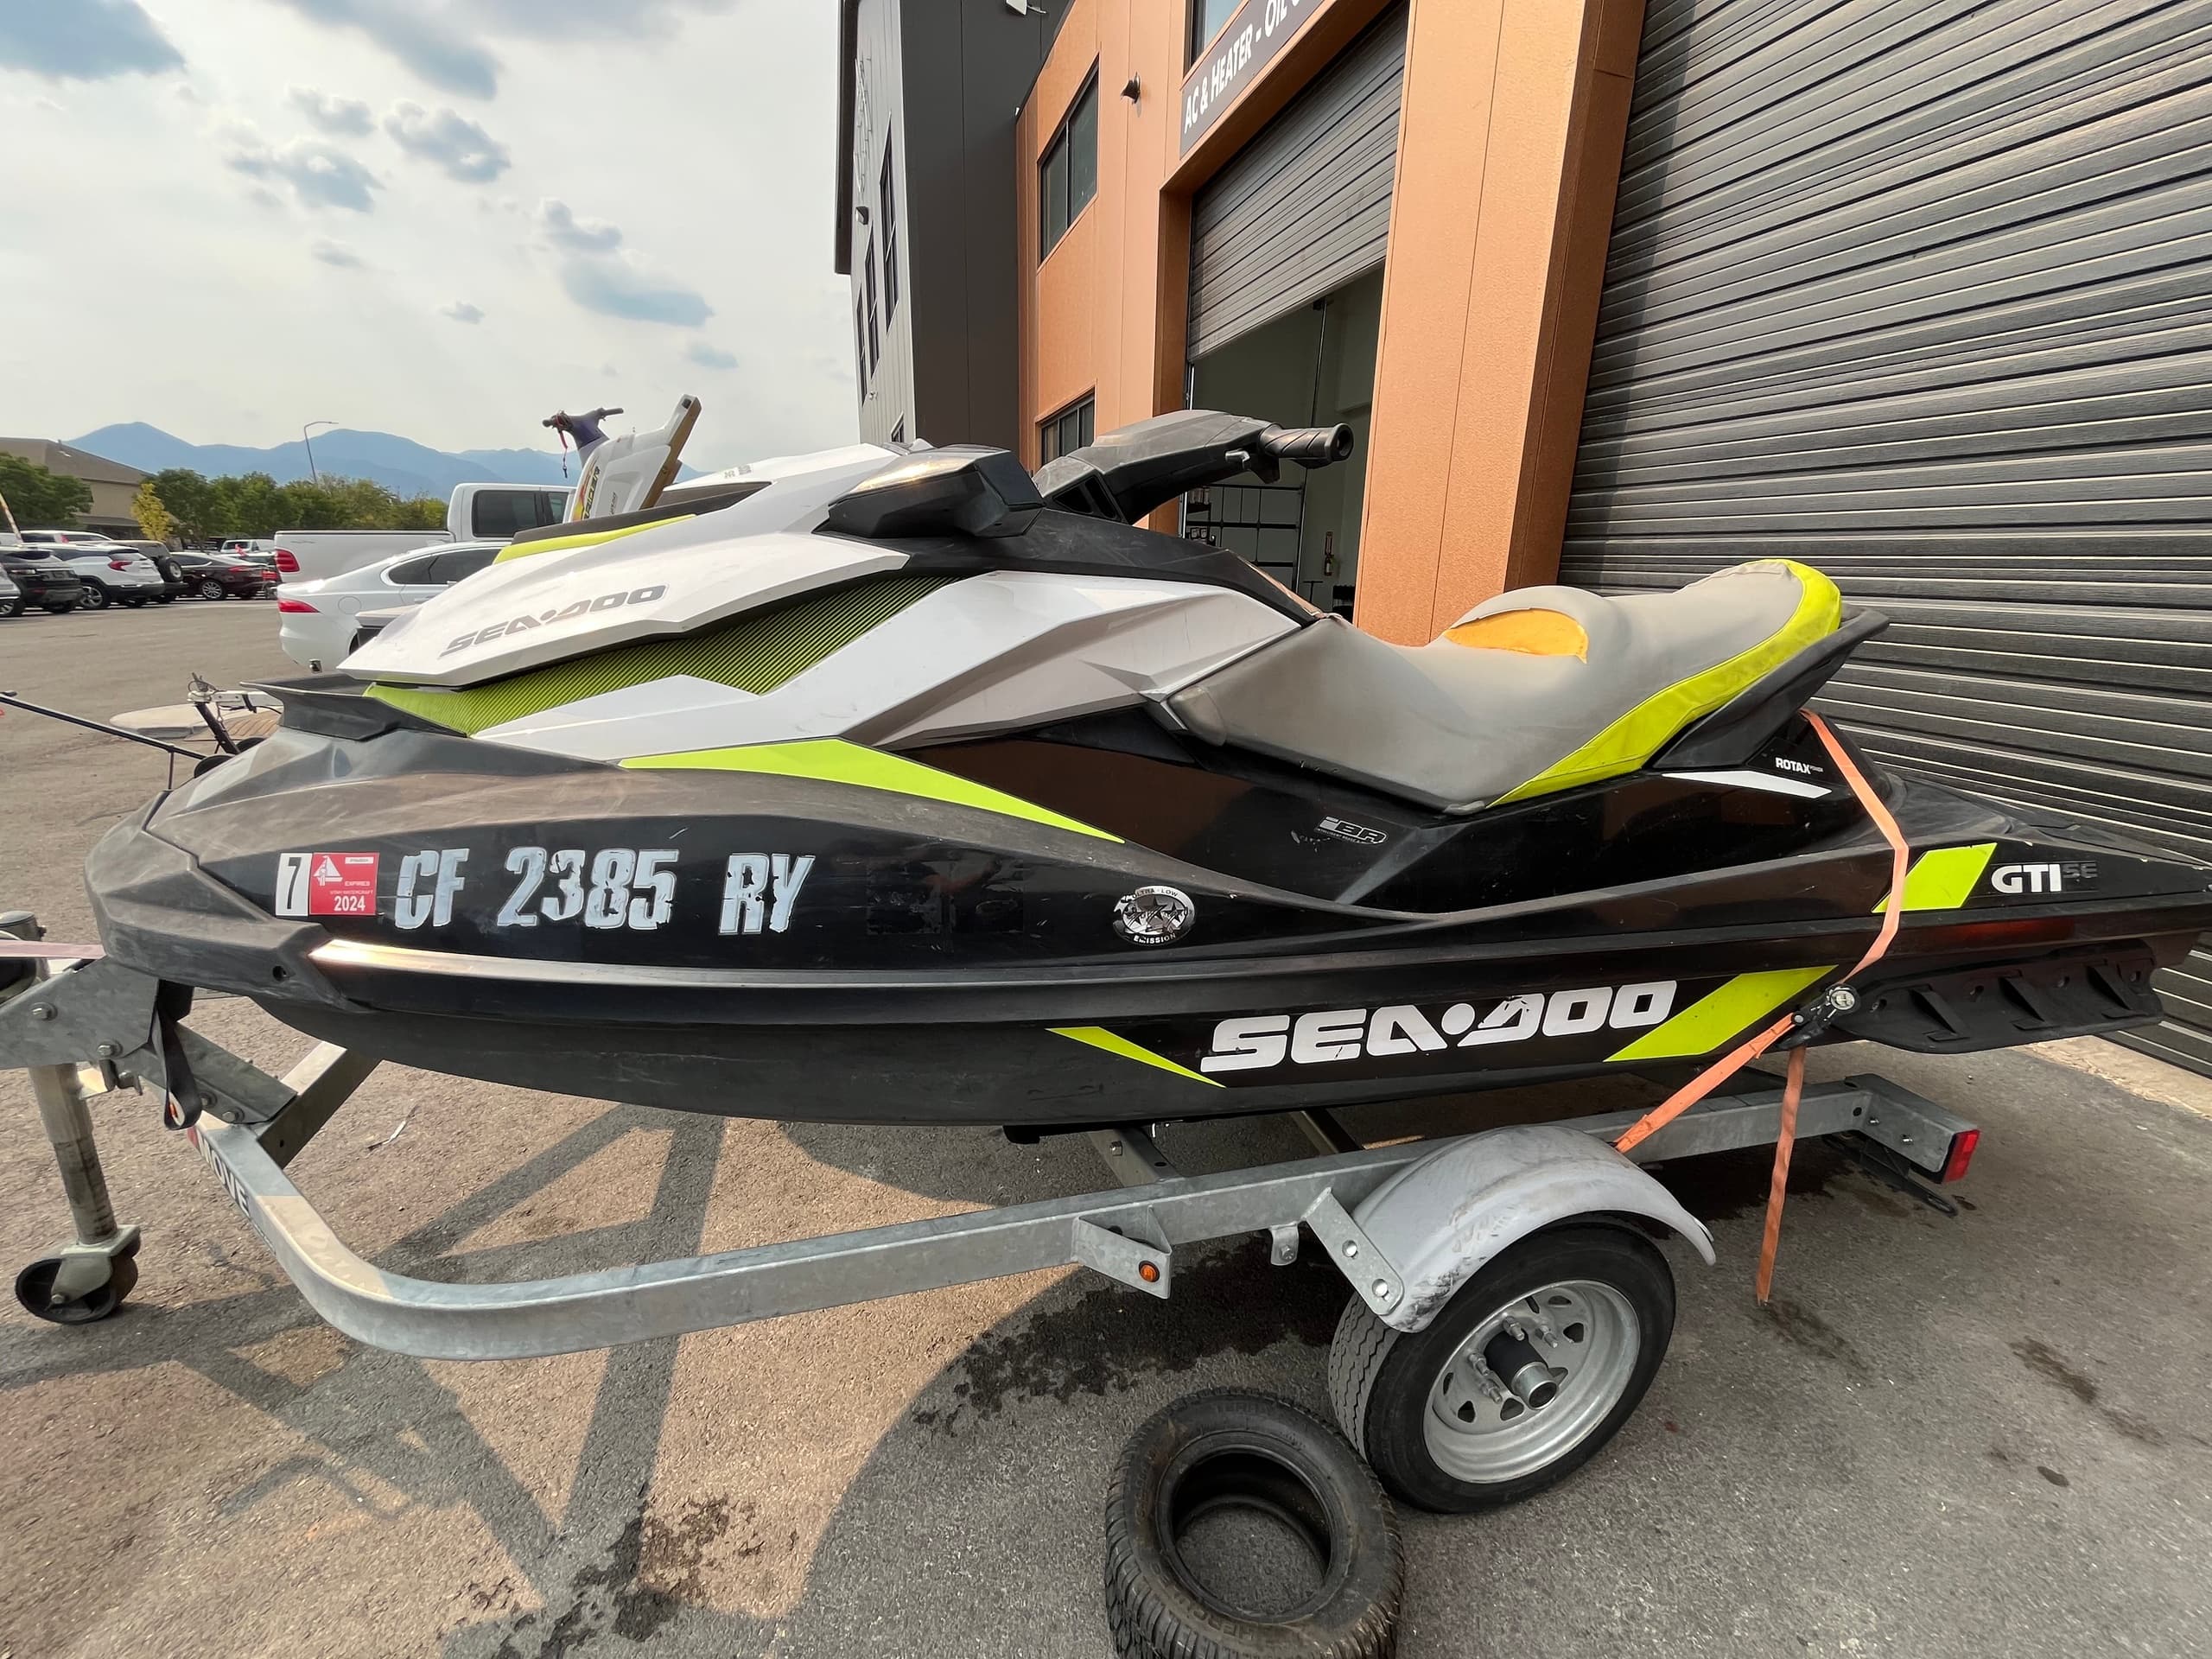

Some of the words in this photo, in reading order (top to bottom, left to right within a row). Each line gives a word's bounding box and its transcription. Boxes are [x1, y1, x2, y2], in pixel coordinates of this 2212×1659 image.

[1184, 86, 1199, 134] AC
[1199, 76, 1208, 115] &
[1211, 23, 1253, 103] HEATER
[1264, 0, 1287, 37] OIL
[1775, 757, 1811, 774] ROTAX
[286, 856, 302, 909] 7
[394, 848, 470, 930] CF
[497, 846, 680, 930] 2385
[718, 853, 816, 936] RY
[1991, 863, 2062, 893] GTI
[334, 895, 365, 912] 2024
